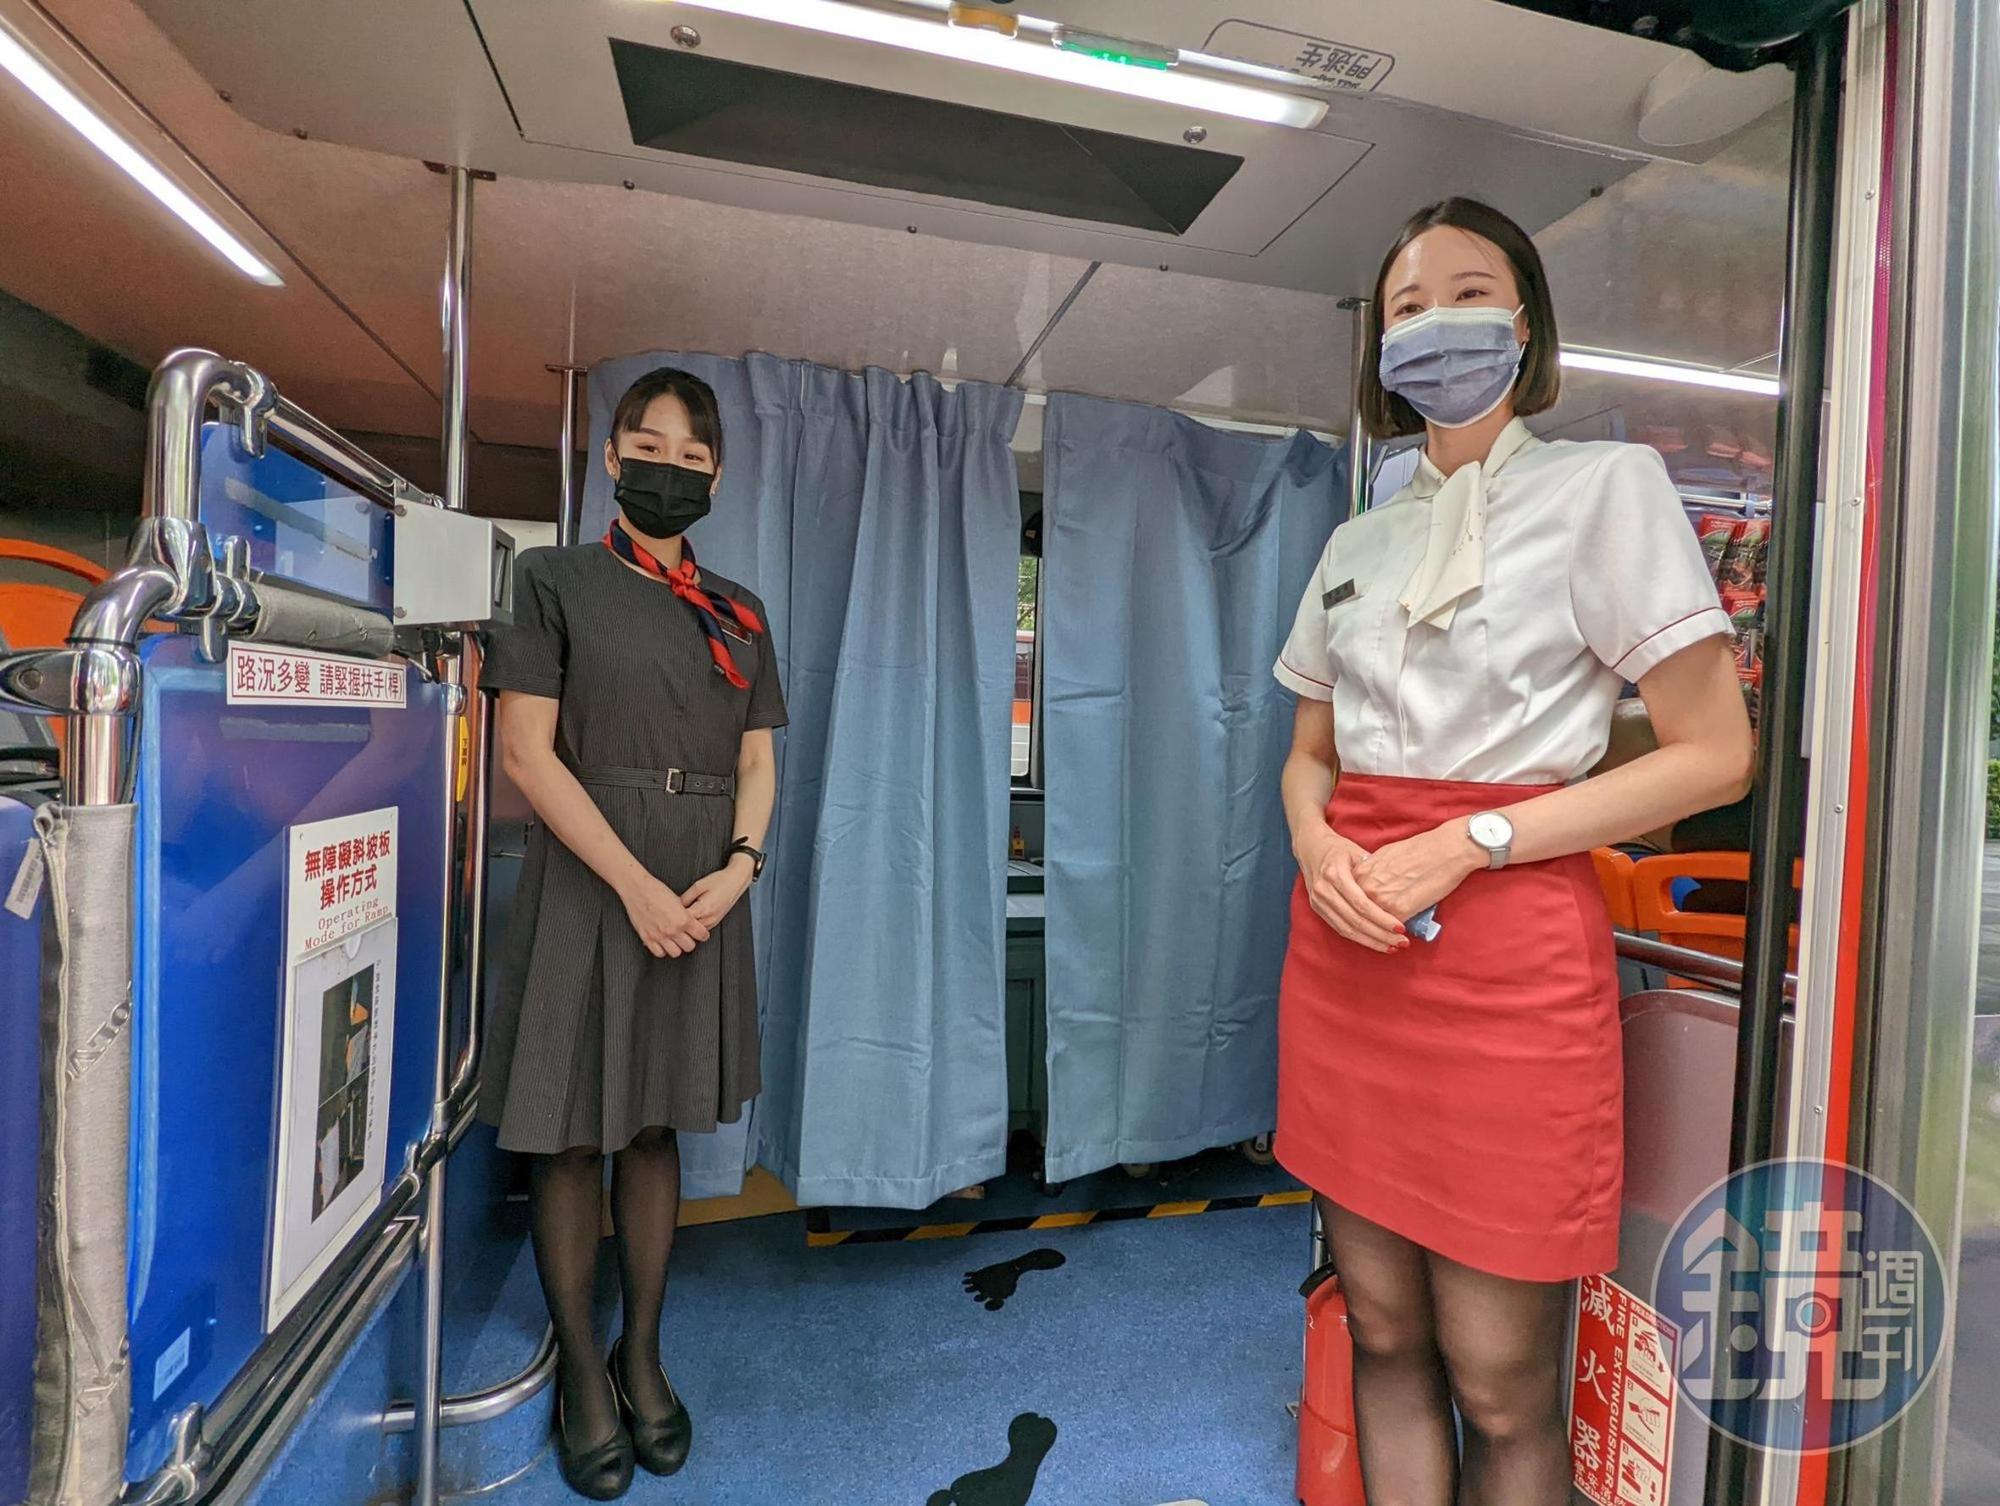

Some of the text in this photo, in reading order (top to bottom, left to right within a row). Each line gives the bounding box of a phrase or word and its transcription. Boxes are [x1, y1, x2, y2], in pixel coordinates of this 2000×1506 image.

[237, 655, 403, 700] 路況多變 請緊握扶手(桿)
[304, 830, 391, 882] 無障礙斜坡板
[320, 863, 378, 910] 操作方式
[304, 905, 389, 951] Mode for Ramp
[318, 898, 379, 930] Operating
[1574, 1277, 1616, 1472] 滅火器
[1604, 1292, 1627, 1488] FIRE EXTINGUISHER
